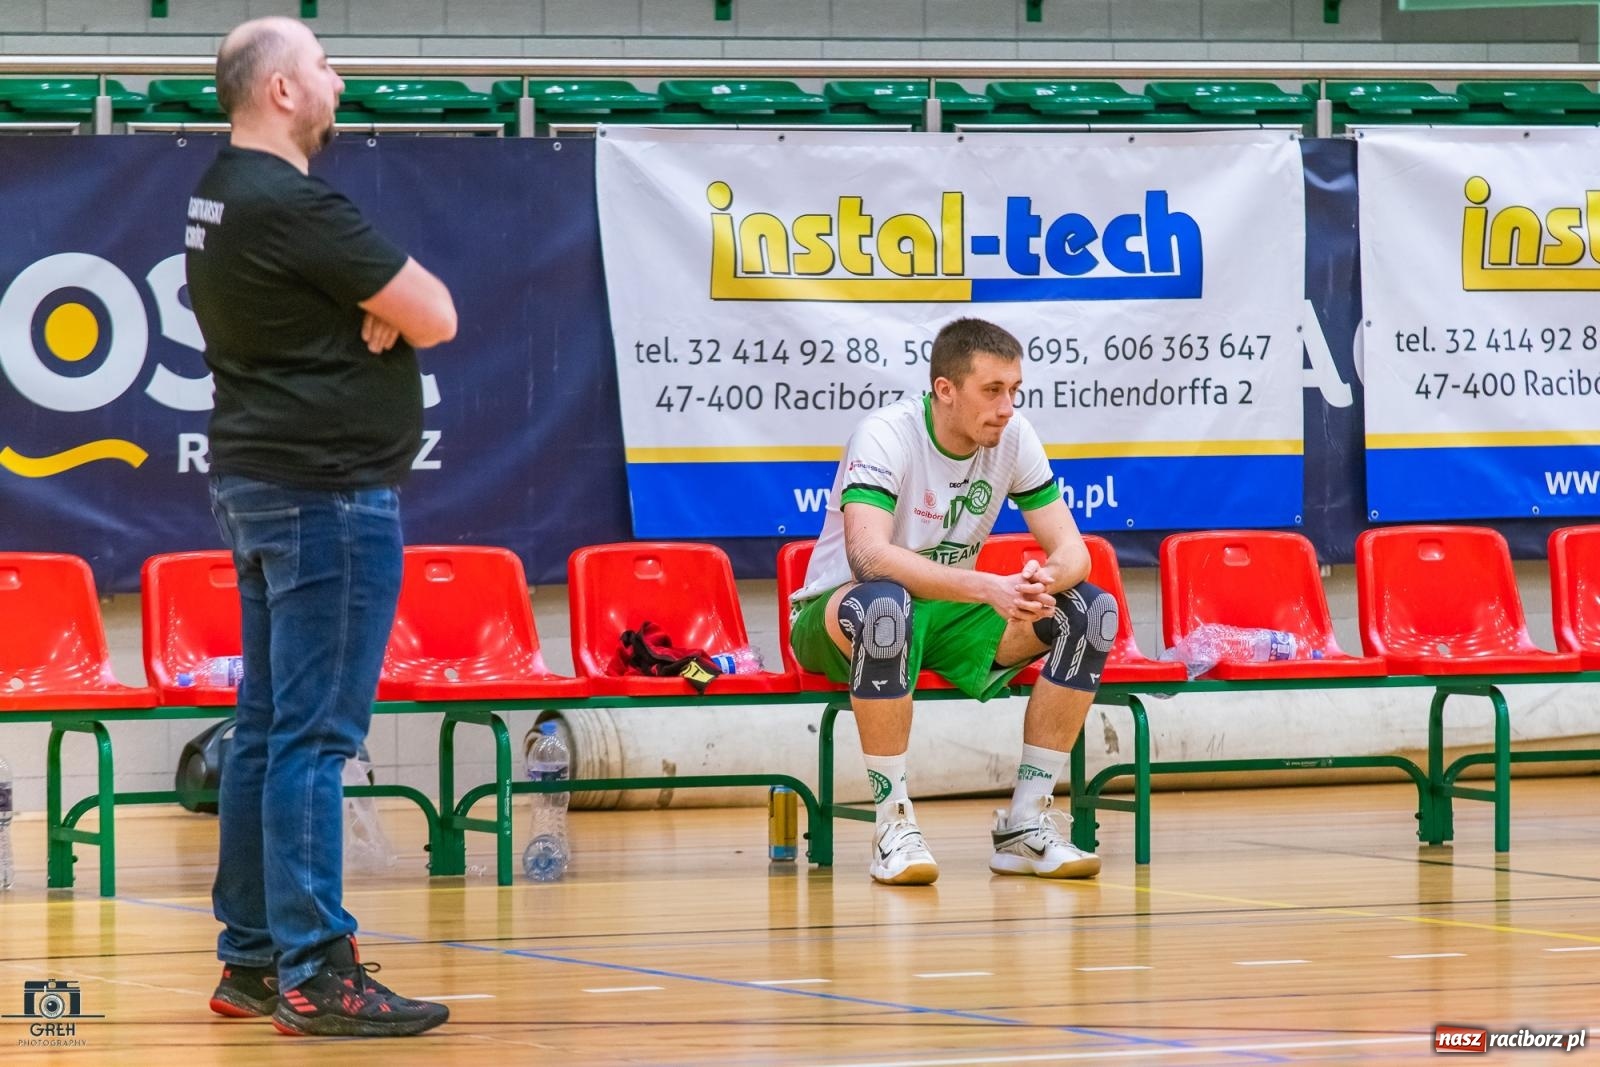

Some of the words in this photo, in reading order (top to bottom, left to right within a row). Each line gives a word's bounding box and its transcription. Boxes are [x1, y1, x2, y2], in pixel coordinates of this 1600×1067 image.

[707, 180, 1203, 302] instal-tech
[635, 336, 678, 364] tel.
[688, 339, 721, 365] 32
[732, 339, 790, 366] 414
[799, 339, 835, 366] 92
[846, 337, 888, 367] 88,
[904, 340, 933, 365] 50
[1027, 336, 1088, 366] 695,
[1104, 335, 1154, 361] 606
[1162, 335, 1209, 361] 363
[1219, 333, 1271, 360] 647
[1395, 326, 1436, 353] tel.
[1445, 328, 1477, 352] 32
[1486, 328, 1533, 354] 414
[1541, 327, 1572, 353] 92
[1582, 325, 1600, 351] 8
[655, 384, 764, 413] 47-400
[775, 382, 905, 411] Racibórz
[1012, 386, 1044, 410] on
[1054, 377, 1228, 409] Eichendorffa
[1238, 380, 1253, 405] 2
[1415, 371, 1516, 401] 47-400
